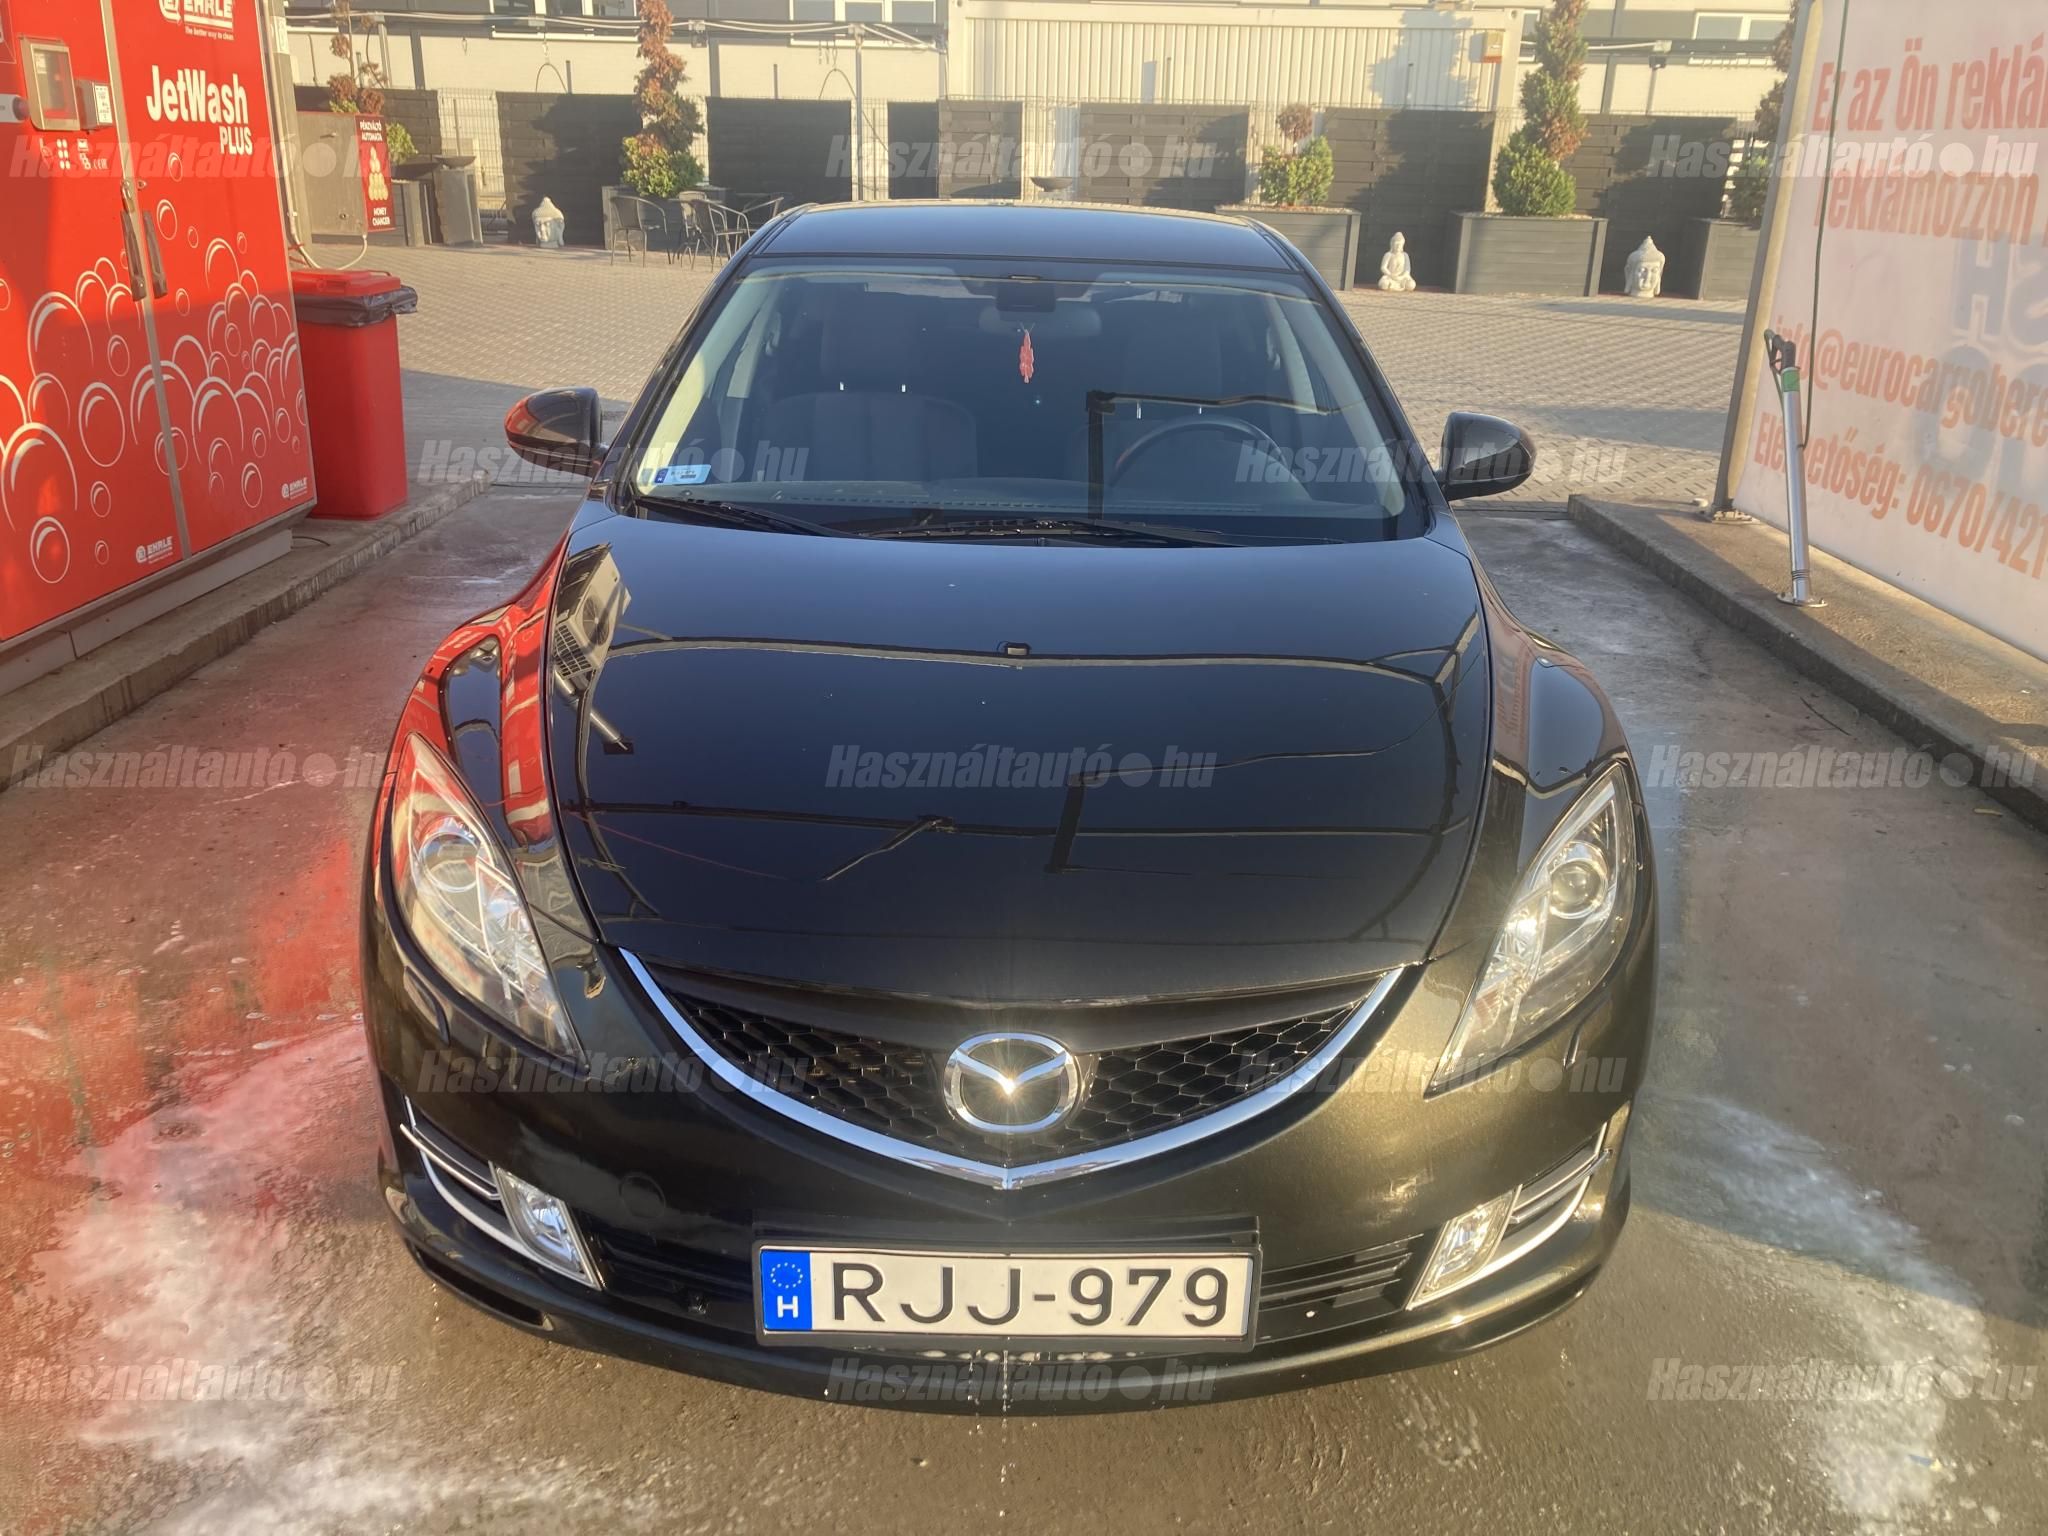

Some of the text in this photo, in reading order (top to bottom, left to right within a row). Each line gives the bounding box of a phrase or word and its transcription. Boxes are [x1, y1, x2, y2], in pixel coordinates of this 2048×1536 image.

[146, 65, 249, 126] JetWash
[1848, 68, 1891, 131] az
[1895, 36, 1939, 131] Ön
[219, 126, 254, 156] PLUS
[371, 216, 391, 227] CHANGER
[373, 206, 387, 216] MONEY
[1776, 314, 2048, 448] o@eurocargobere
[1754, 411, 1906, 520] Eléetőség:
[777, 1295, 799, 1318] H
[832, 1261, 1230, 1328] RJJ-979
